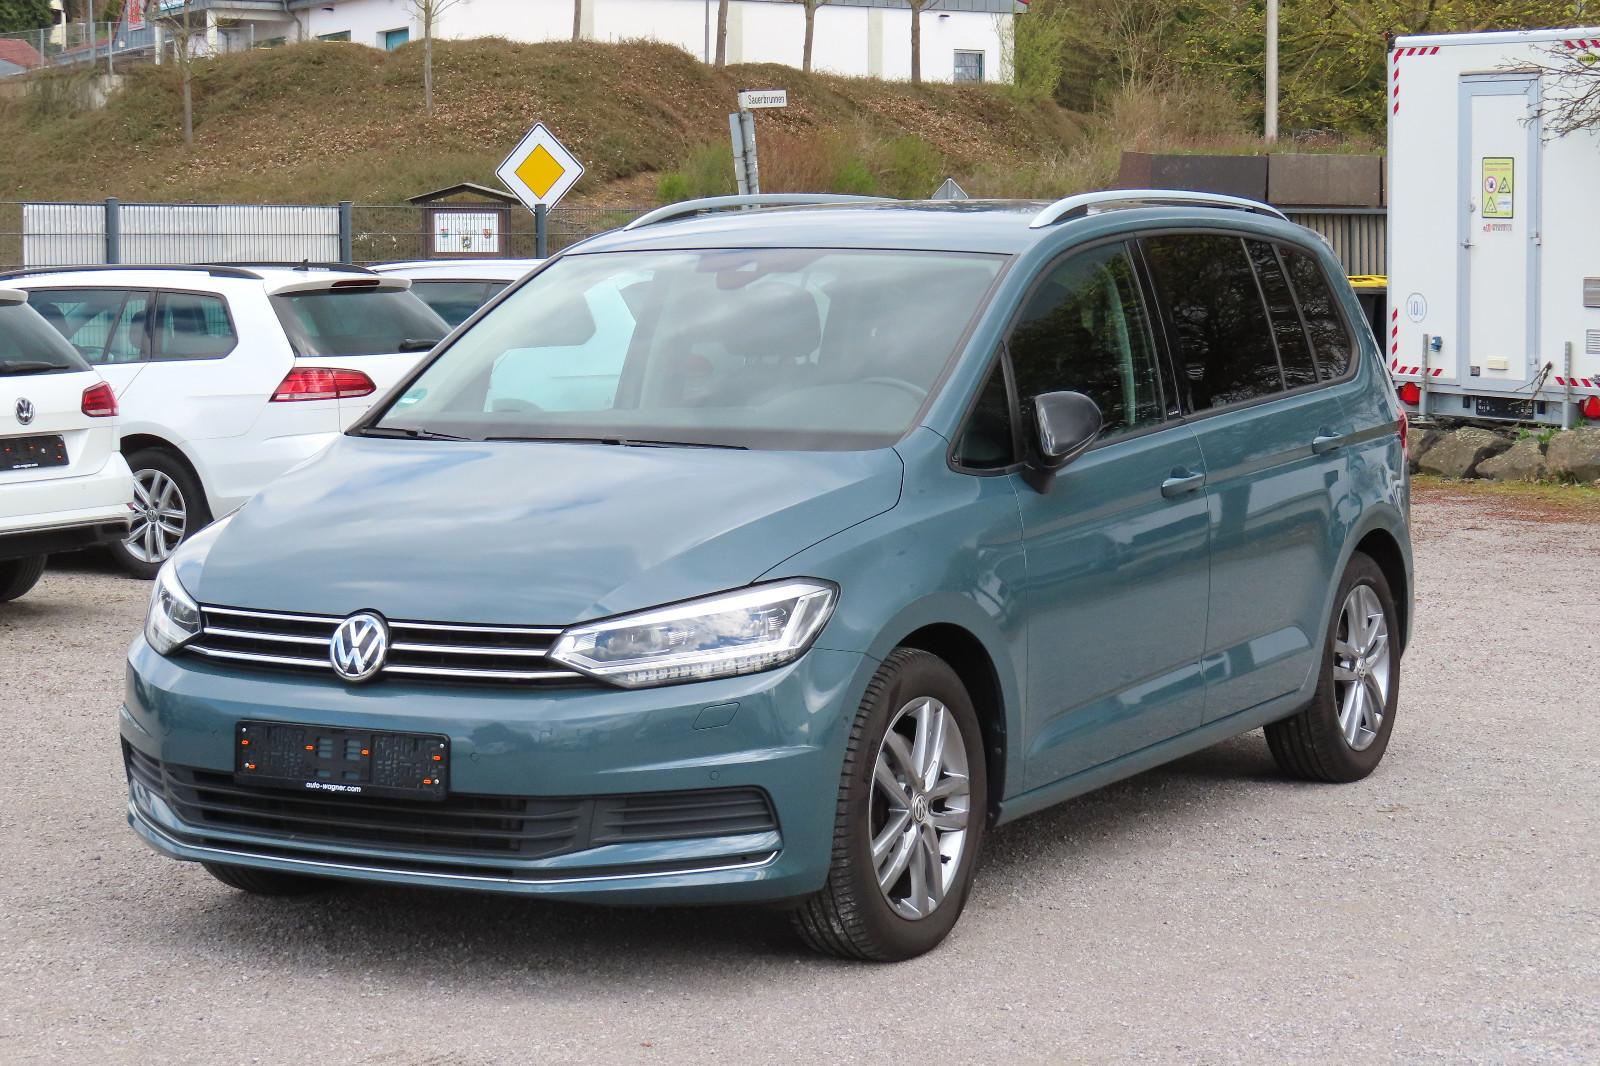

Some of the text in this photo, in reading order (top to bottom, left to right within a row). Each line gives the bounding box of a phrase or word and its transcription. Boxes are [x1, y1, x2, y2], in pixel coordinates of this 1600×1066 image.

[747, 94, 785, 105] Sauerbrunnen
[331, 614, 386, 680] VW
[305, 781, 362, 793] auto-wagner.com
